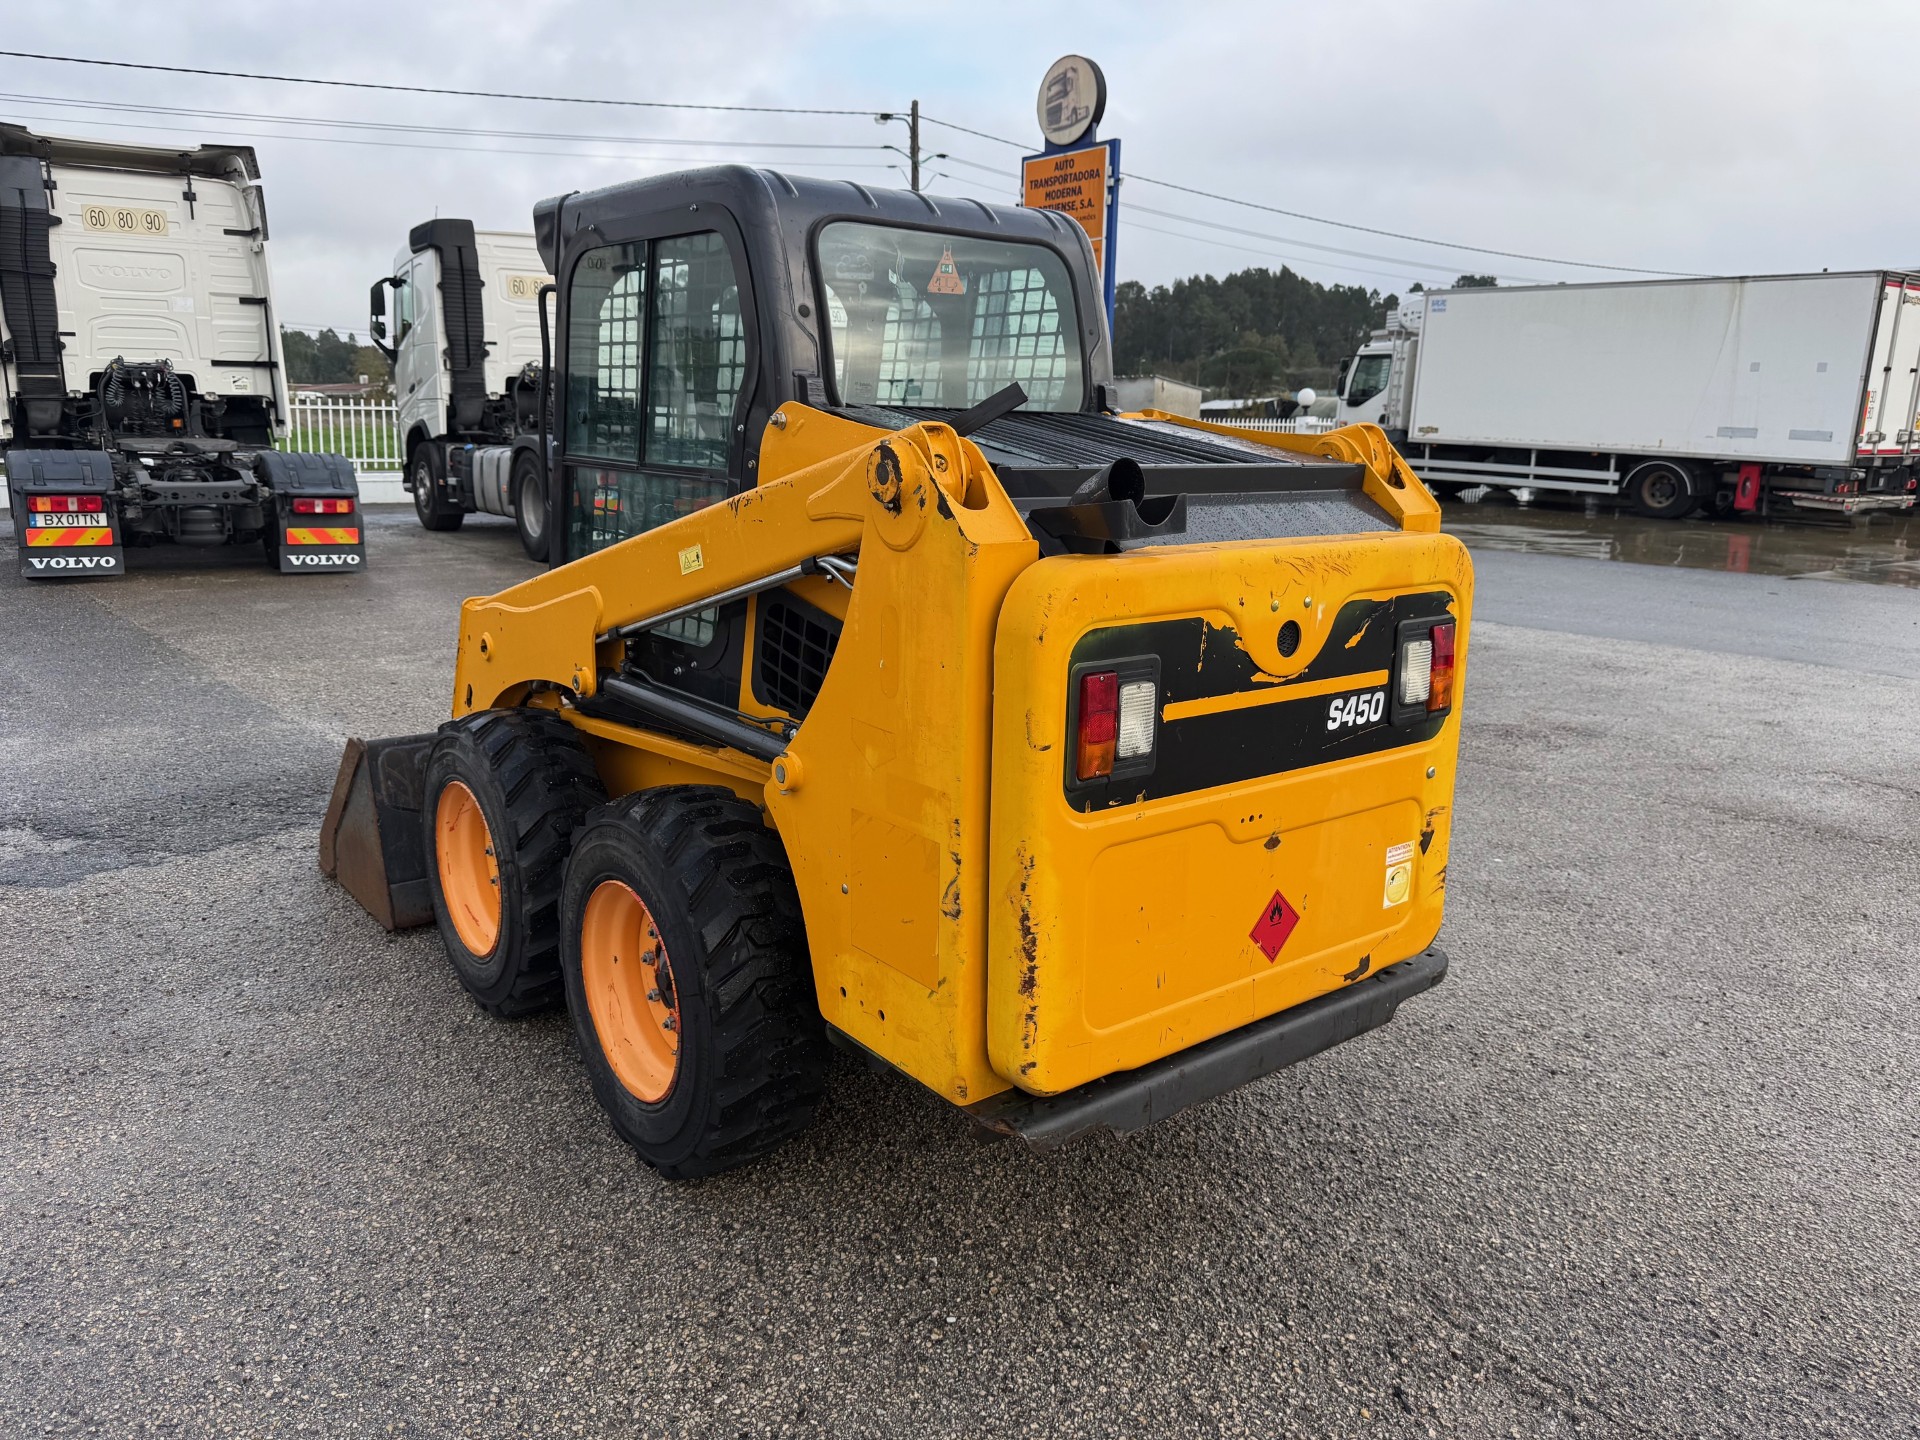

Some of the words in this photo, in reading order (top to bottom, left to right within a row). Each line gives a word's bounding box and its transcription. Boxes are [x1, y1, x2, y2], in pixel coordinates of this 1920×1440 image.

[1054, 159, 1075, 172] AUTO
[1029, 168, 1100, 190] TRANSPORTADORA
[1045, 186, 1082, 201] MODERNA
[1038, 200, 1078, 213] TUENSE,
[1079, 198, 1095, 210] S.A.
[89, 209, 106, 227] 60
[117, 211, 134, 229] 80
[145, 213, 161, 231] 90
[88, 264, 172, 280] VOLVO
[512, 279, 525, 295] 60
[28, 556, 116, 569] VOLVO
[287, 554, 360, 566] VOLVO
[1327, 691, 1385, 731] S450
[1271, 946, 1276, 954] 3
